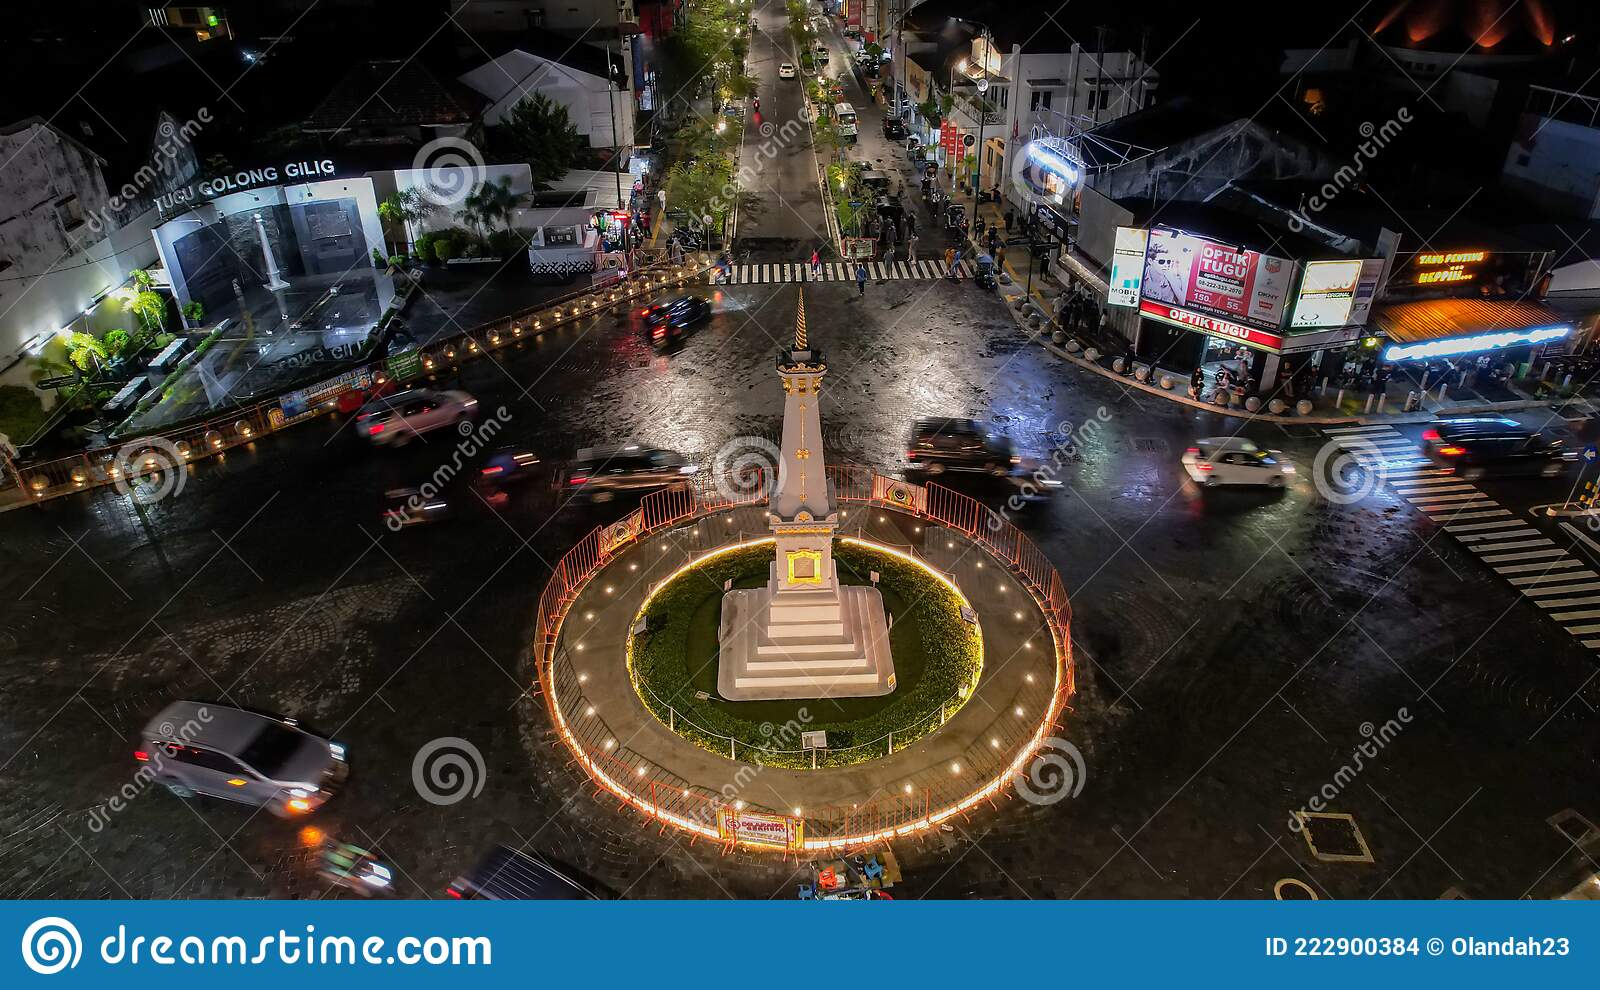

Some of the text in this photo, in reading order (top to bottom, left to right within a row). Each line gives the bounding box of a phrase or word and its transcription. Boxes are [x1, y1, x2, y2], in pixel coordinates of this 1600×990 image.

[198, 167, 278, 196] GOLONG
[284, 160, 335, 177] GILIG
[1203, 247, 1248, 267] OPTIK
[1202, 258, 1247, 278] TUGU
[1203, 273, 1240, 285] optiktugu.com
[1111, 288, 1137, 296] MOBIL
[1194, 292, 1210, 302] 150
[1257, 291, 1279, 300] DKNY
[1226, 301, 1239, 310] 55
[1169, 309, 1210, 329] OPTIK
[1210, 320, 1250, 338] TUGU
